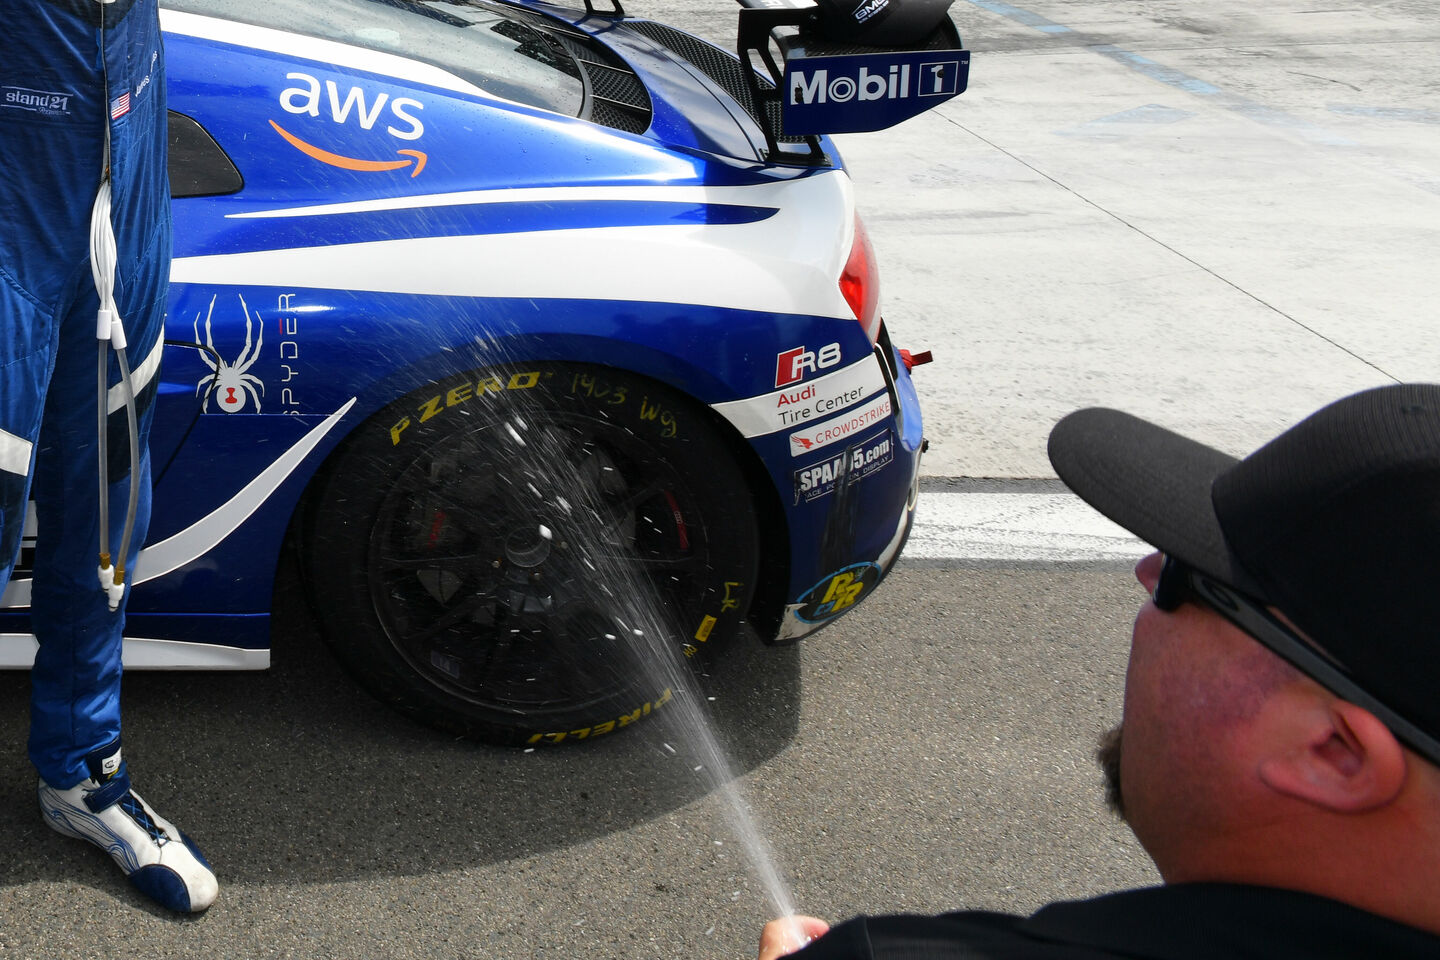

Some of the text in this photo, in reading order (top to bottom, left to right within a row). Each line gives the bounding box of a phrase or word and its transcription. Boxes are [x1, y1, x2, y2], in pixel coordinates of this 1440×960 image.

[789, 64, 910, 106] Mobil
[279, 72, 425, 141] aws
[791, 342, 841, 379] R8
[390, 371, 541, 446] P ZERO
[777, 384, 816, 408] Audi
[777, 386, 864, 425] Tire Center
[815, 401, 891, 444] CROWDSTRIKE
[527, 687, 672, 745] PIRELLI
